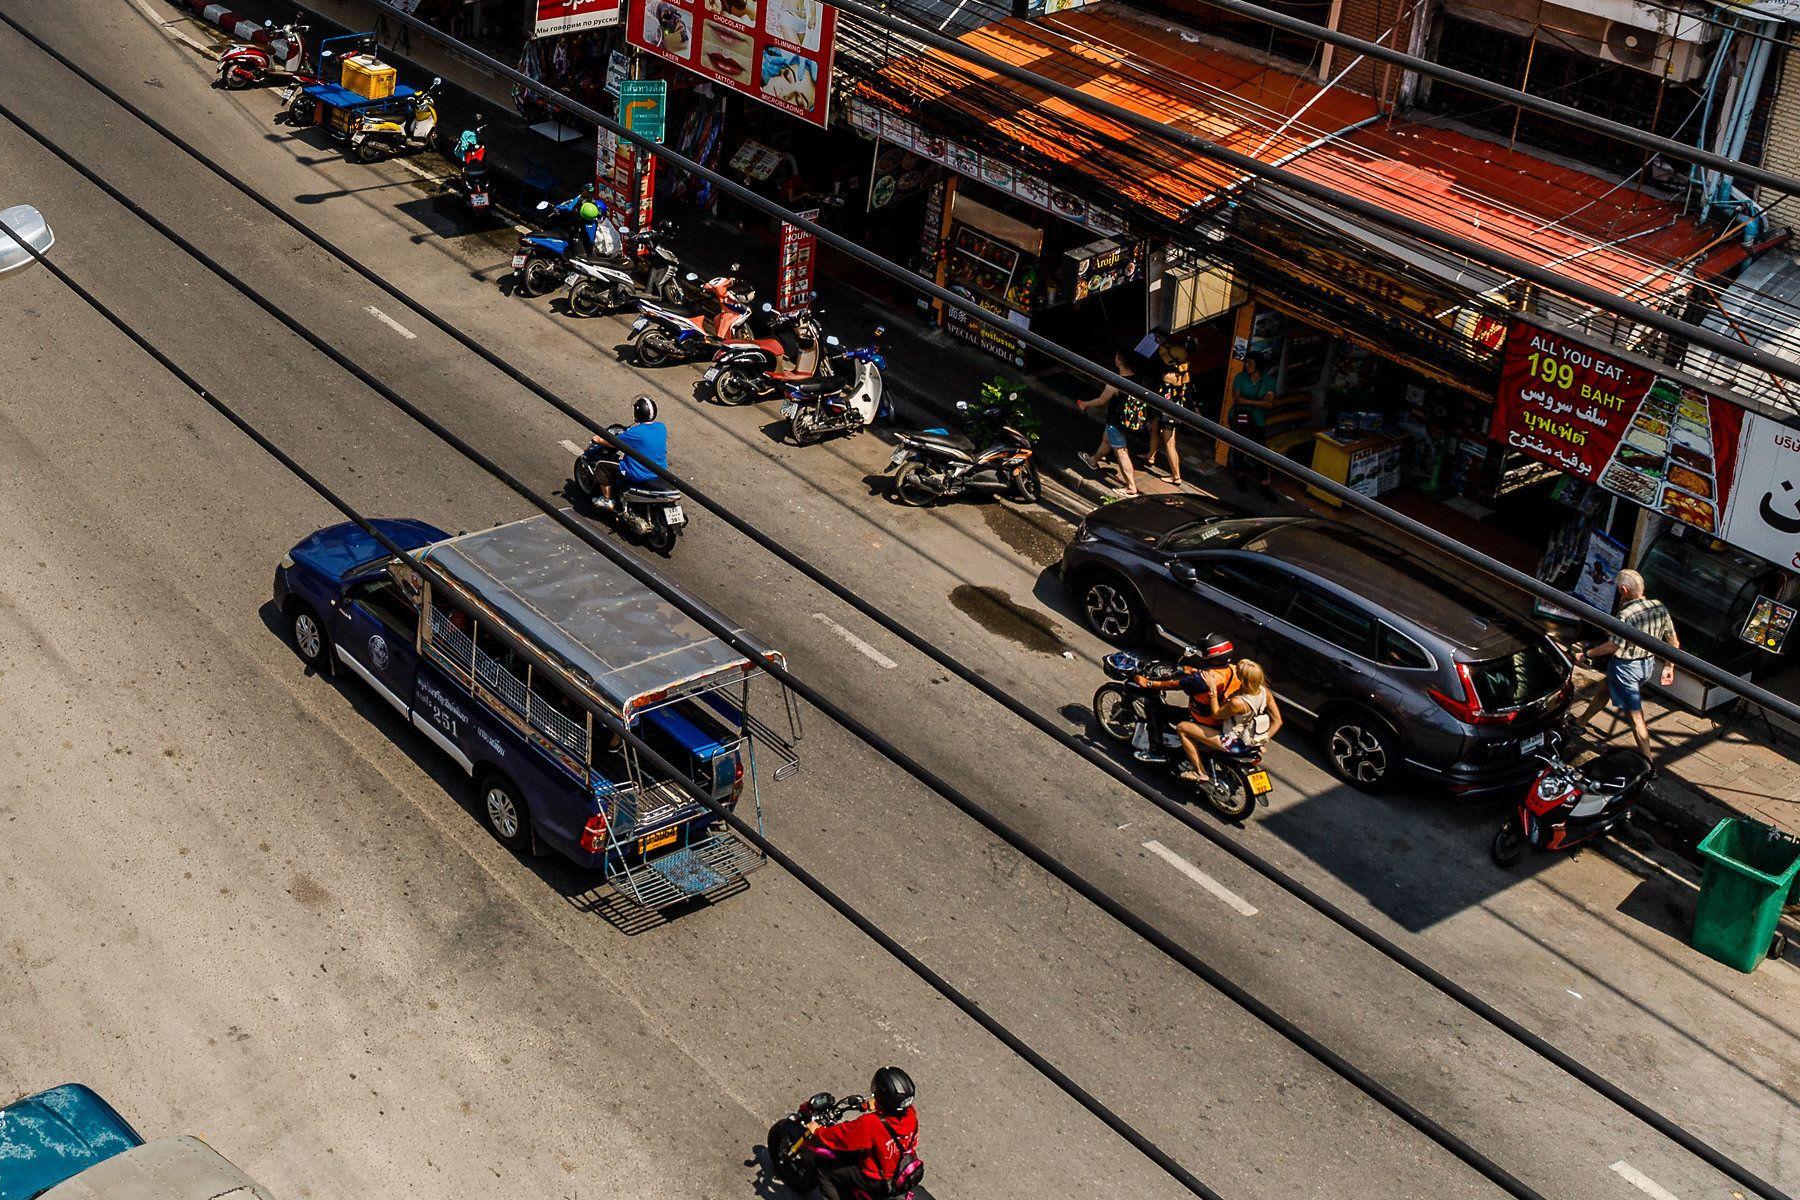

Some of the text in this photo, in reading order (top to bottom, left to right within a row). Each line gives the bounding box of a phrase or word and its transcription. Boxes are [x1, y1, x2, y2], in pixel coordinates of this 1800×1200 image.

[550, 21, 582, 34] говорим
[582, 19, 593, 28] по
[712, 13, 746, 32] CHOCOLATE
[661, 50, 680, 63] LASER
[773, 37, 802, 54] SLIMMING
[714, 72, 736, 87] TATTOO
[760, 91, 805, 117] MICROBLADING
[947, 322, 1015, 363] SPECIAL NOODLE
[1530, 335, 1559, 357] ALL
[1561, 345, 1592, 369] YOU
[1595, 360, 1625, 382] EAT
[1526, 352, 1626, 412] 199 BAHT
[433, 705, 458, 738] 251
